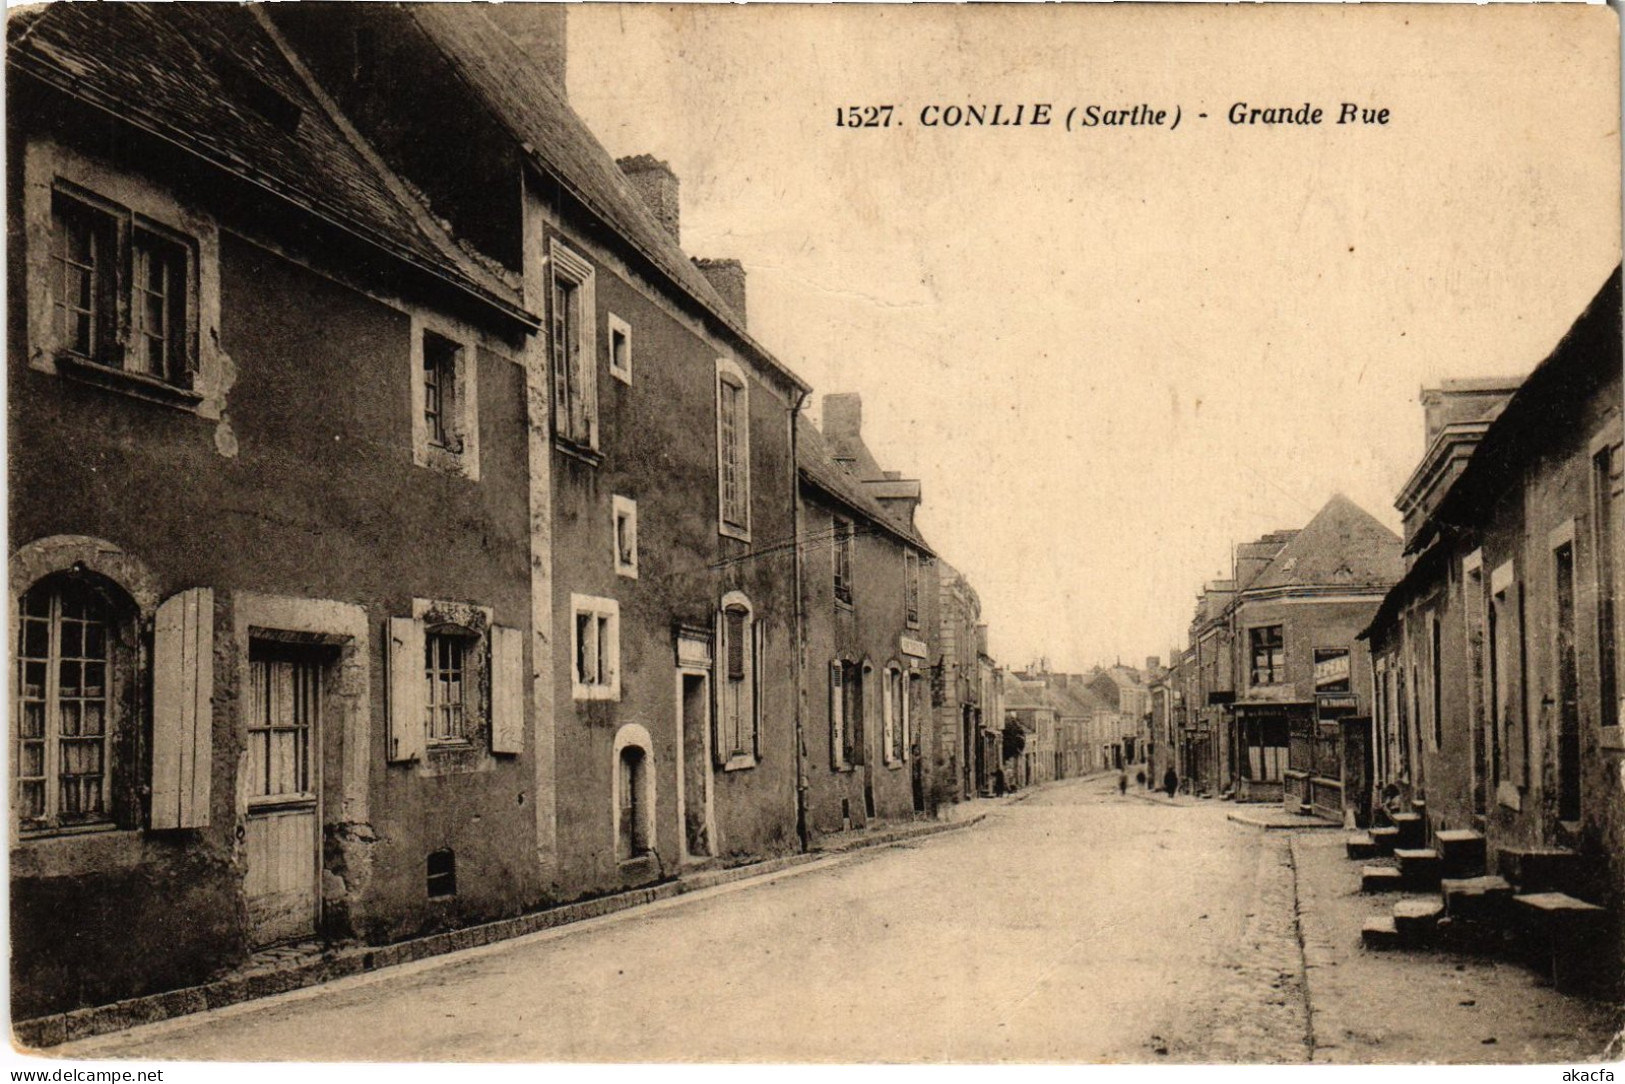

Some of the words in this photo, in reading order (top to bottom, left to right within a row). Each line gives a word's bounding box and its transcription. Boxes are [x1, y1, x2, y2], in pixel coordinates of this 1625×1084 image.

[921, 104, 1052, 127] CONLIE
[1066, 103, 1182, 132] (Sarthe)
[1228, 103, 1323, 125] Grande
[1336, 102, 1390, 125] Rue
